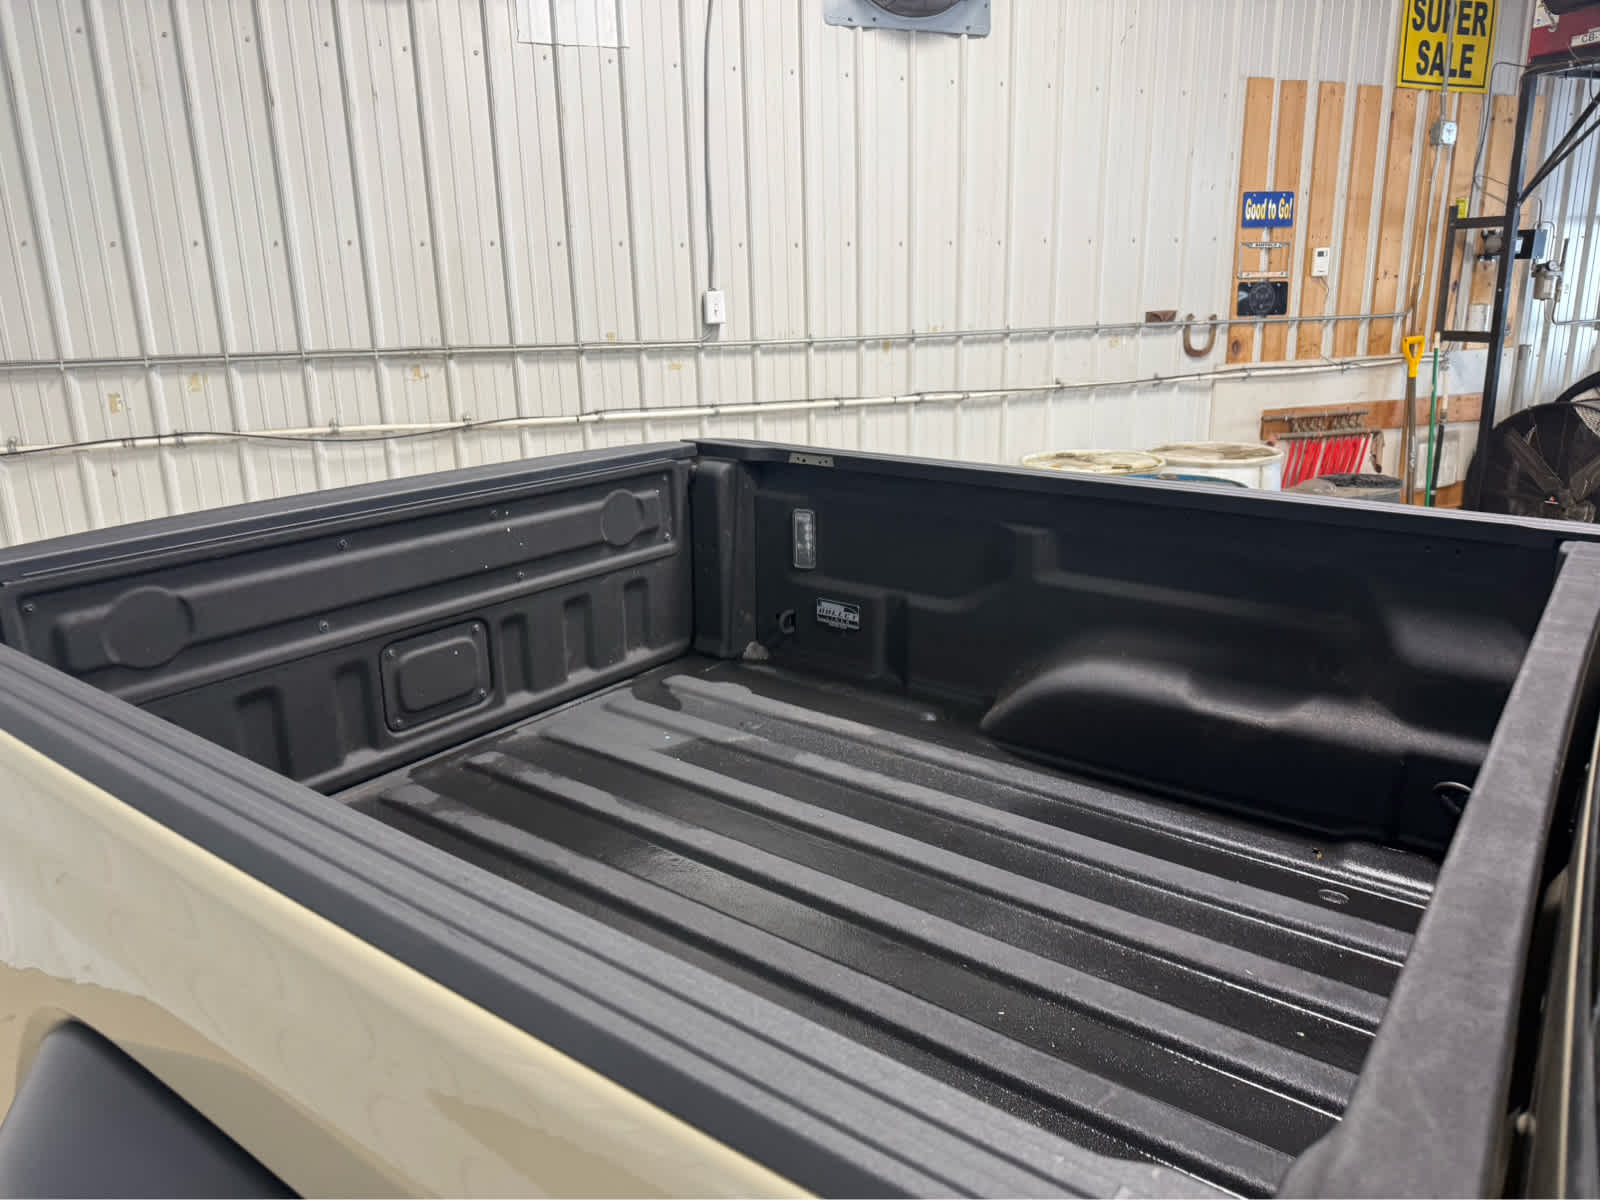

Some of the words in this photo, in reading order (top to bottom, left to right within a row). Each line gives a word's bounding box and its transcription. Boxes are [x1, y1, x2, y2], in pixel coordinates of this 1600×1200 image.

[1412, 0, 1488, 37] SUPER
[1416, 39, 1475, 79] SALE
[1245, 198, 1268, 220] Good
[1267, 199, 1277, 220] to
[1278, 197, 1293, 220] Go!
